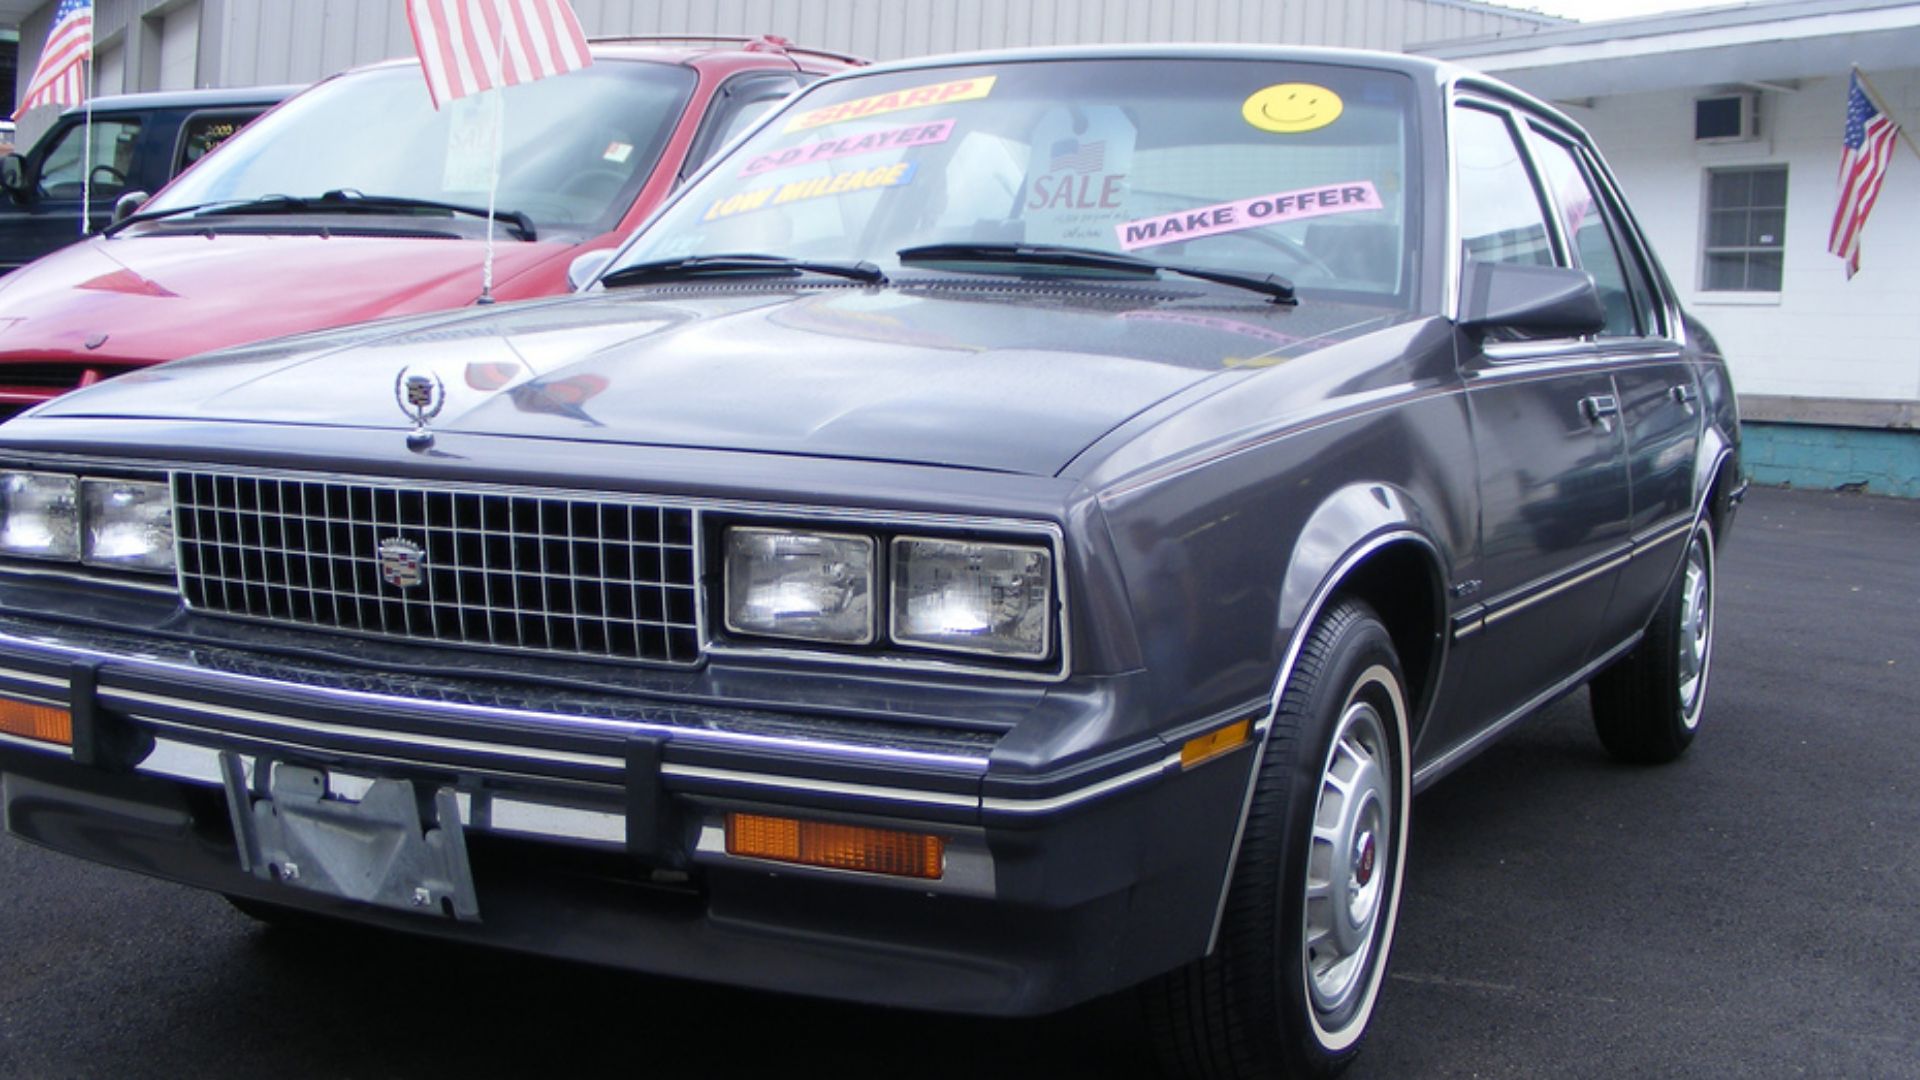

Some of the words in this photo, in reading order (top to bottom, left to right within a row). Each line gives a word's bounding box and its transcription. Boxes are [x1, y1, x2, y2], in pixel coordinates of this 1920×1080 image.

[801, 82, 975, 128] SHARP
[809, 122, 946, 158] PLAYER
[703, 187, 776, 221] LOW
[772, 162, 909, 205] MILEAGE
[1028, 174, 1127, 210] SALE
[1126, 207, 1235, 243] MAKE
[1247, 186, 1367, 218] OFFER
